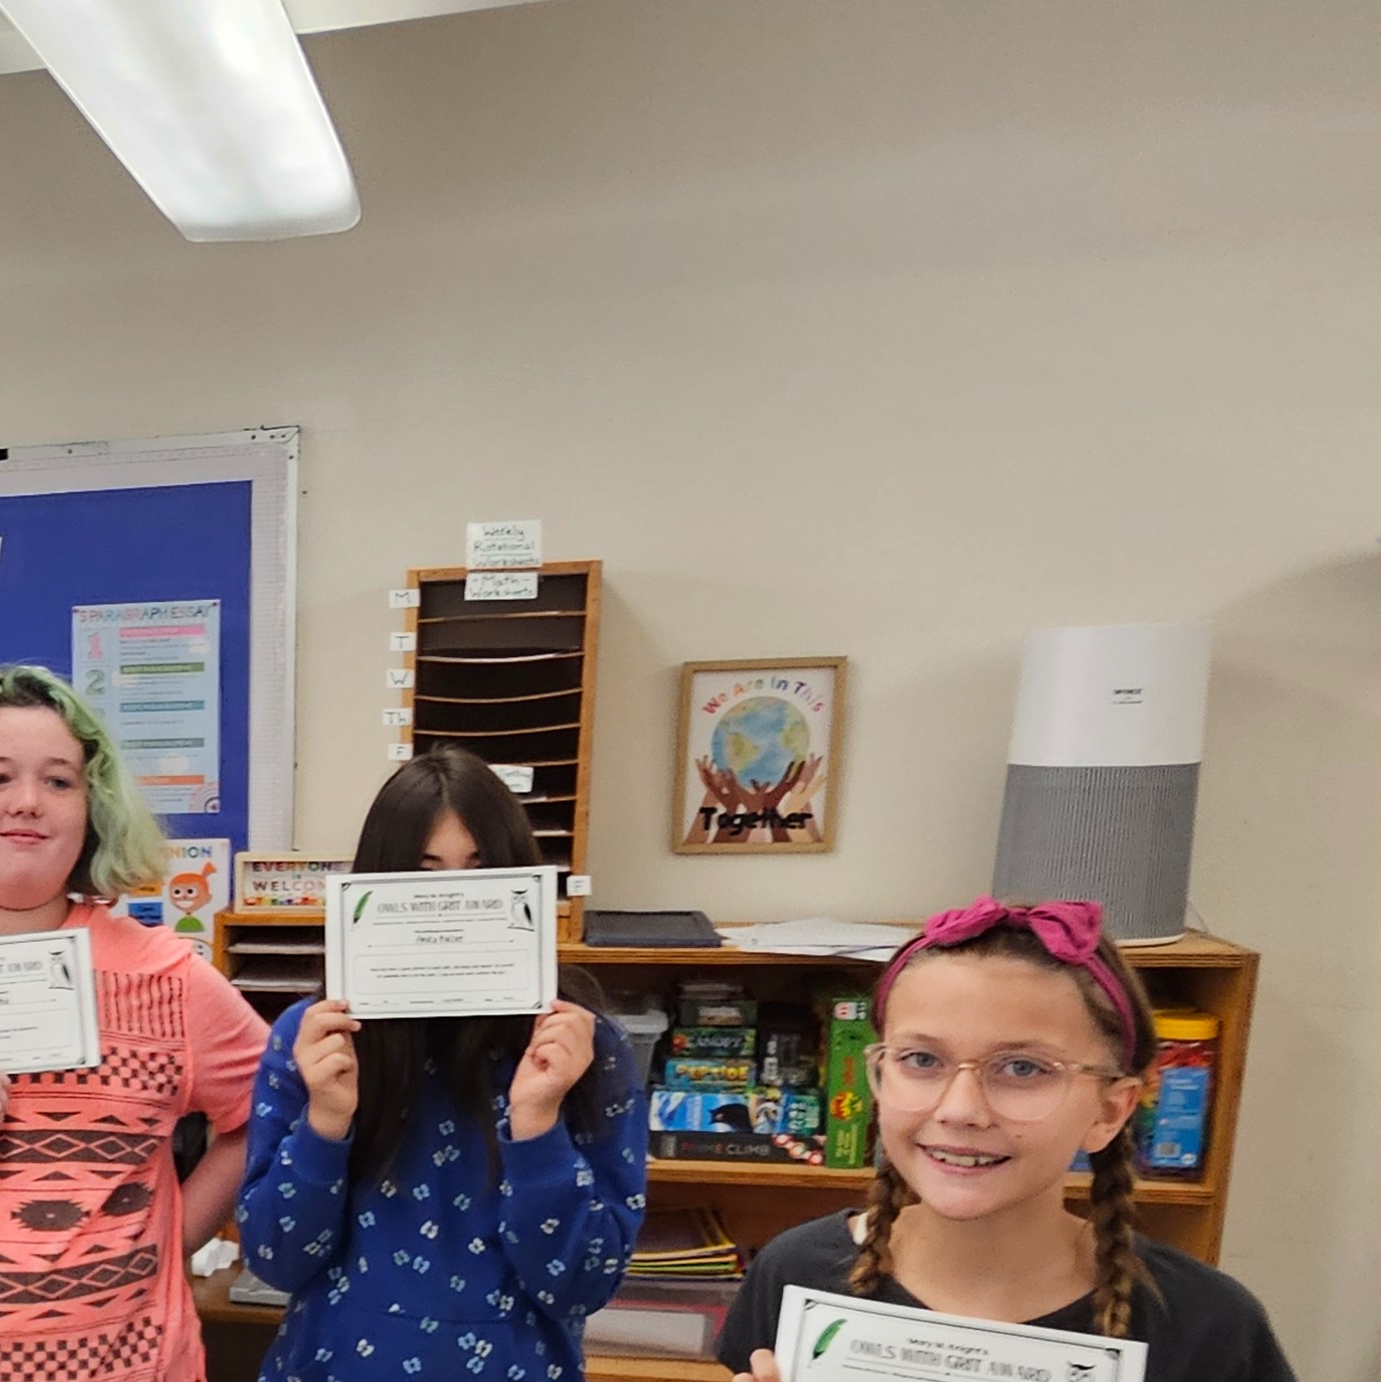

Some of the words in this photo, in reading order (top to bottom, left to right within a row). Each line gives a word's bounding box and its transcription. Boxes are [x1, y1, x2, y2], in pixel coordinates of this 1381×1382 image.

[395, 591, 410, 603] M
[89, 607, 168, 622] PARAGRAPH
[170, 604, 210, 619] ESSAY
[87, 631, 103, 659] 1
[394, 635, 409, 649] T
[85, 669, 106, 696] 2
[390, 671, 409, 685] W
[702, 692, 727, 714] We
[733, 678, 764, 697] Are
[771, 675, 789, 691] In
[794, 680, 825, 714] This
[385, 711, 406, 724] Th
[698, 807, 814, 836] Together
[252, 861, 343, 872] EVERYONE
[849, 1338, 897, 1360] OWLS
[900, 1347, 942, 1367] WITH
[944, 1354, 984, 1373] GRIT
